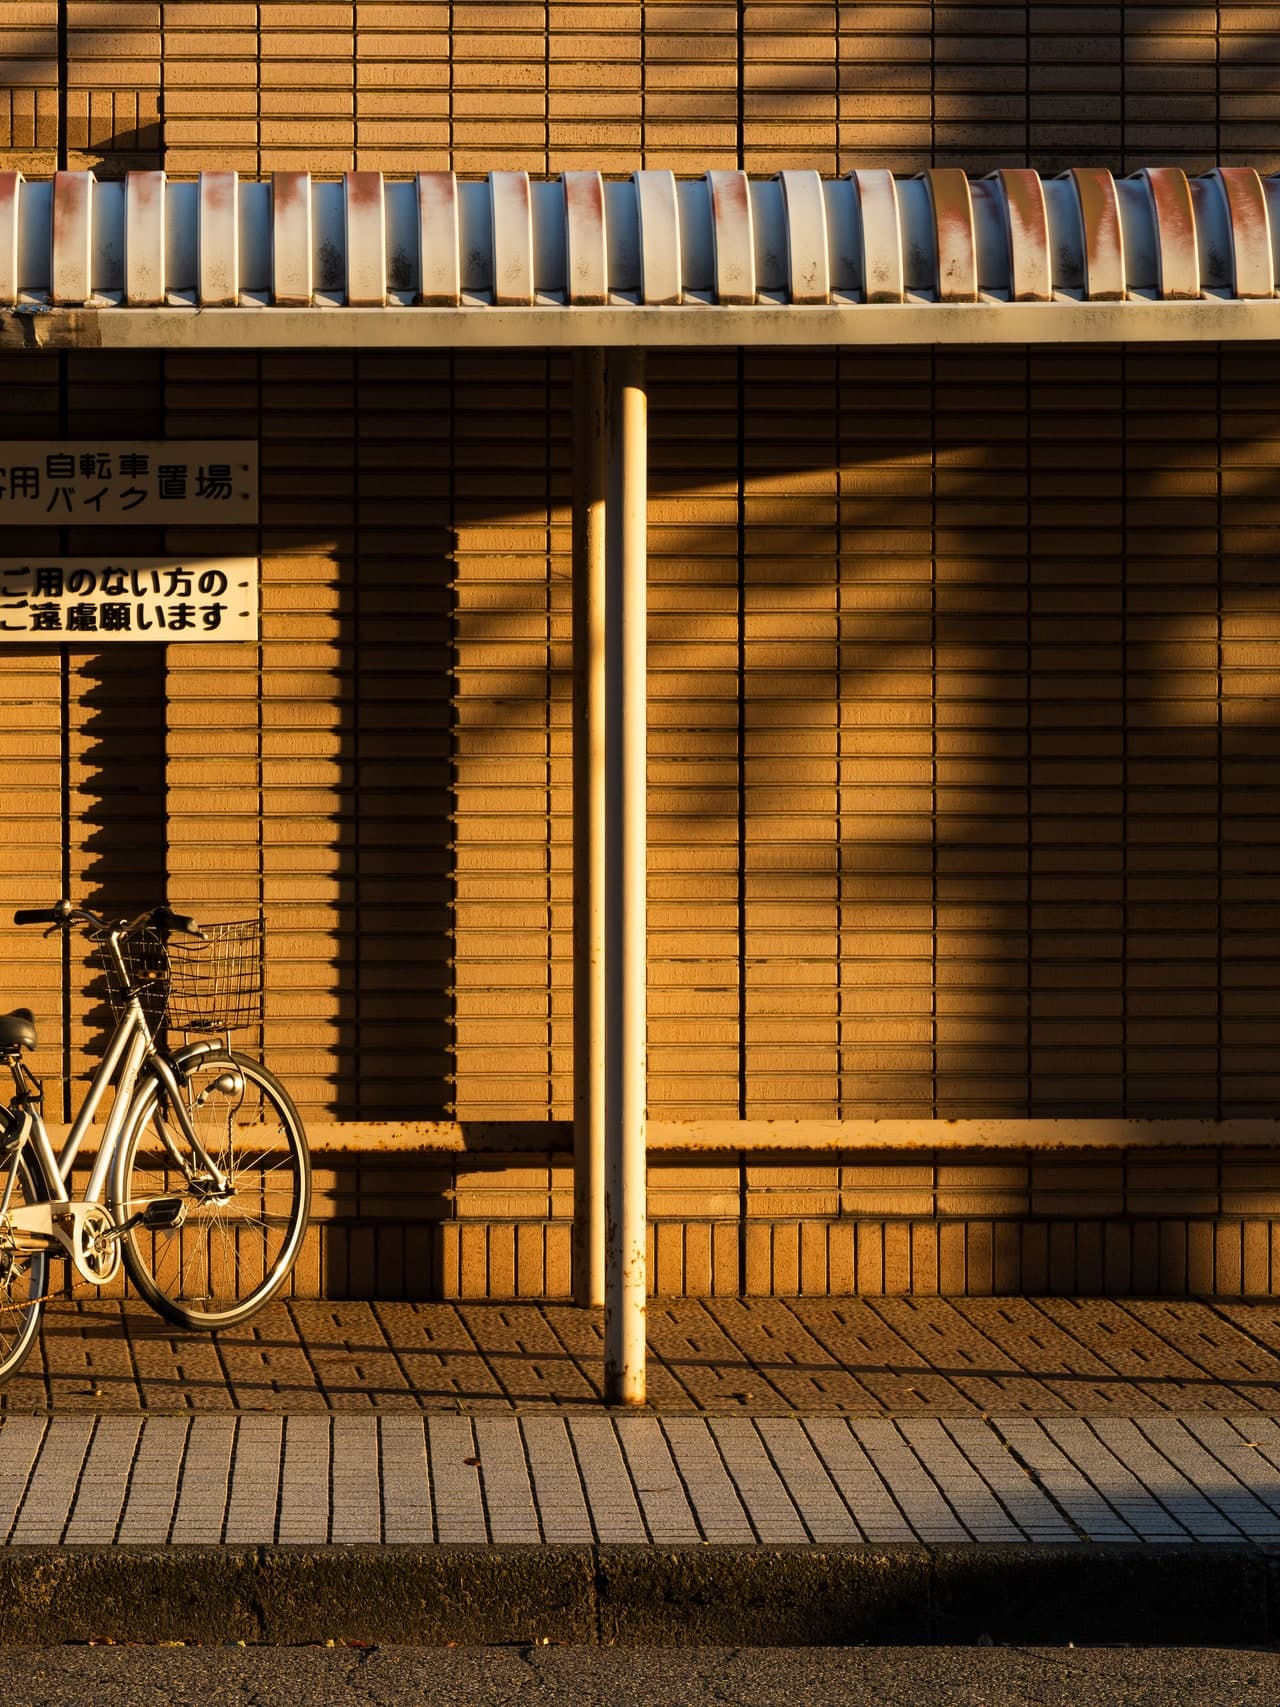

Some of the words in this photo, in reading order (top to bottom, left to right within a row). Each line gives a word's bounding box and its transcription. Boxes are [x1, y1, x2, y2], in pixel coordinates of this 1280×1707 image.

[46, 453, 150, 480] 自転車
[157, 464, 233, 500] 置場
[46, 487, 149, 512] バイク
